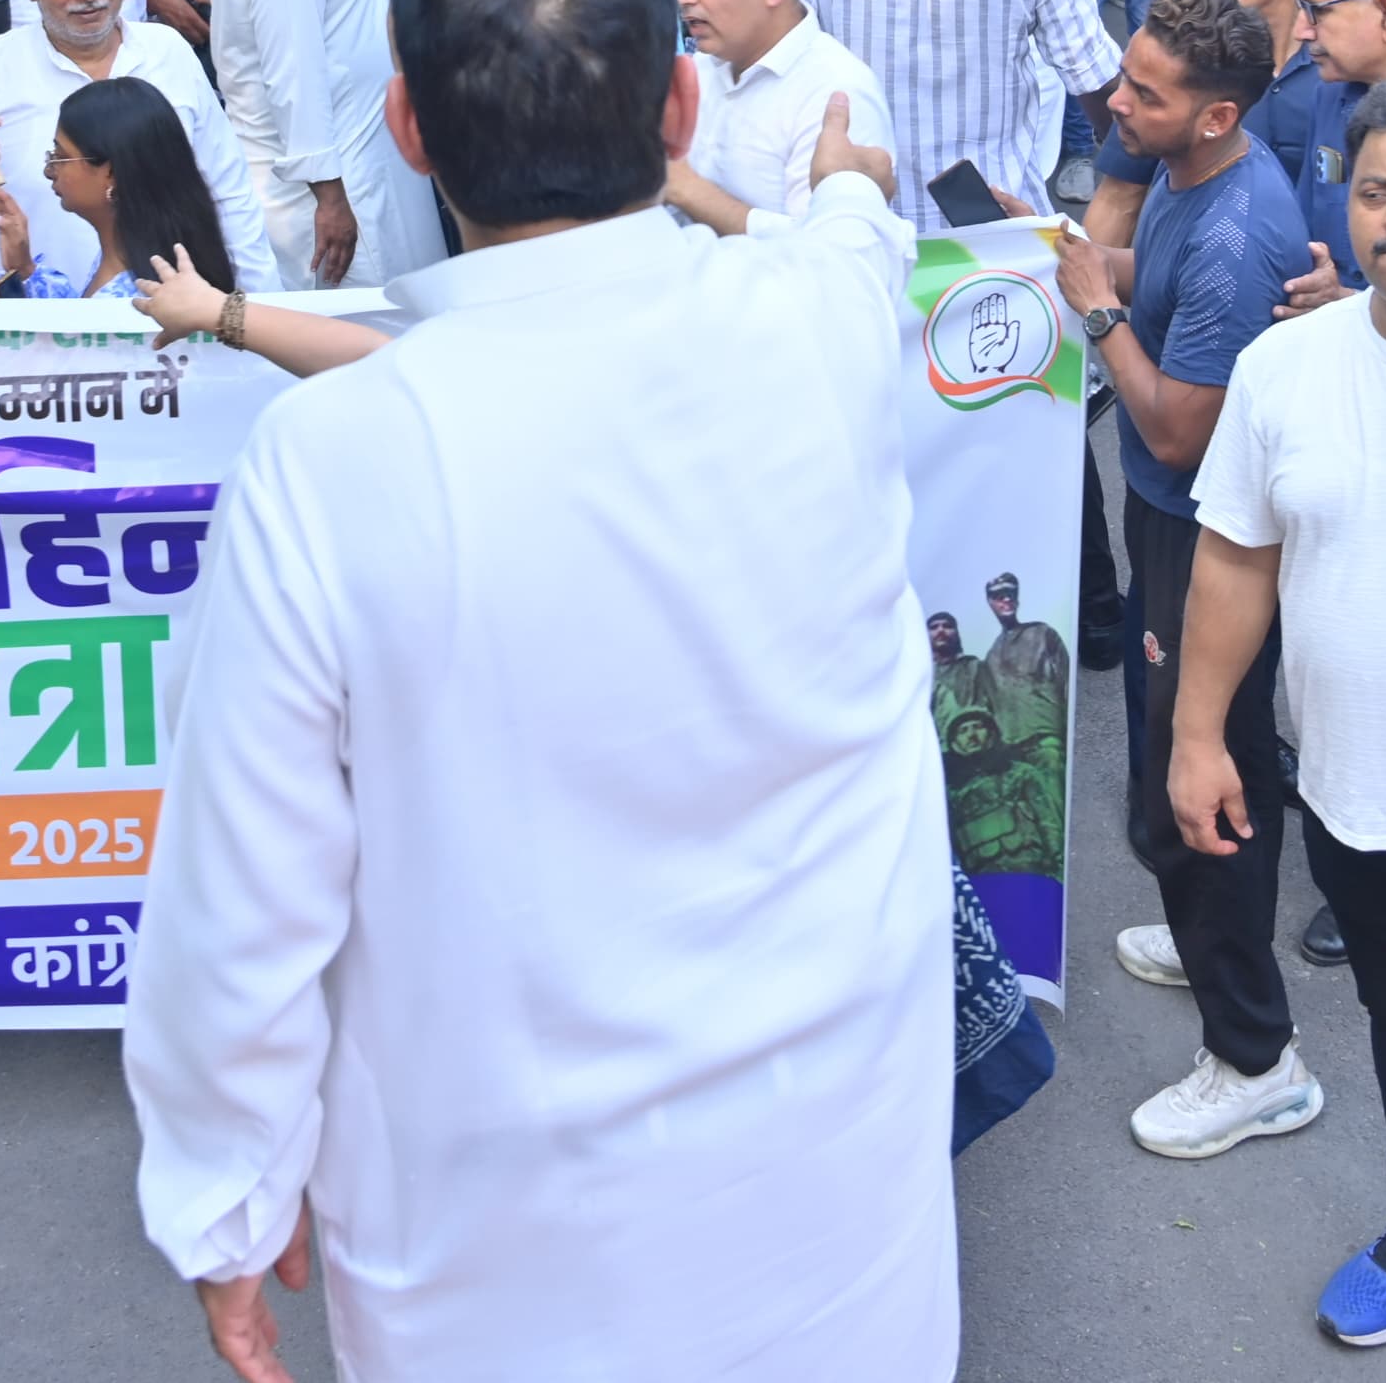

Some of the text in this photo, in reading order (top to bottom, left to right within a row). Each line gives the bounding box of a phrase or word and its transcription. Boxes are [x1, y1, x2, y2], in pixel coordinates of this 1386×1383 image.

[135, 354, 189, 418] में
[8, 818, 144, 867] 2025
[5, 915, 139, 989] कांग्रे
